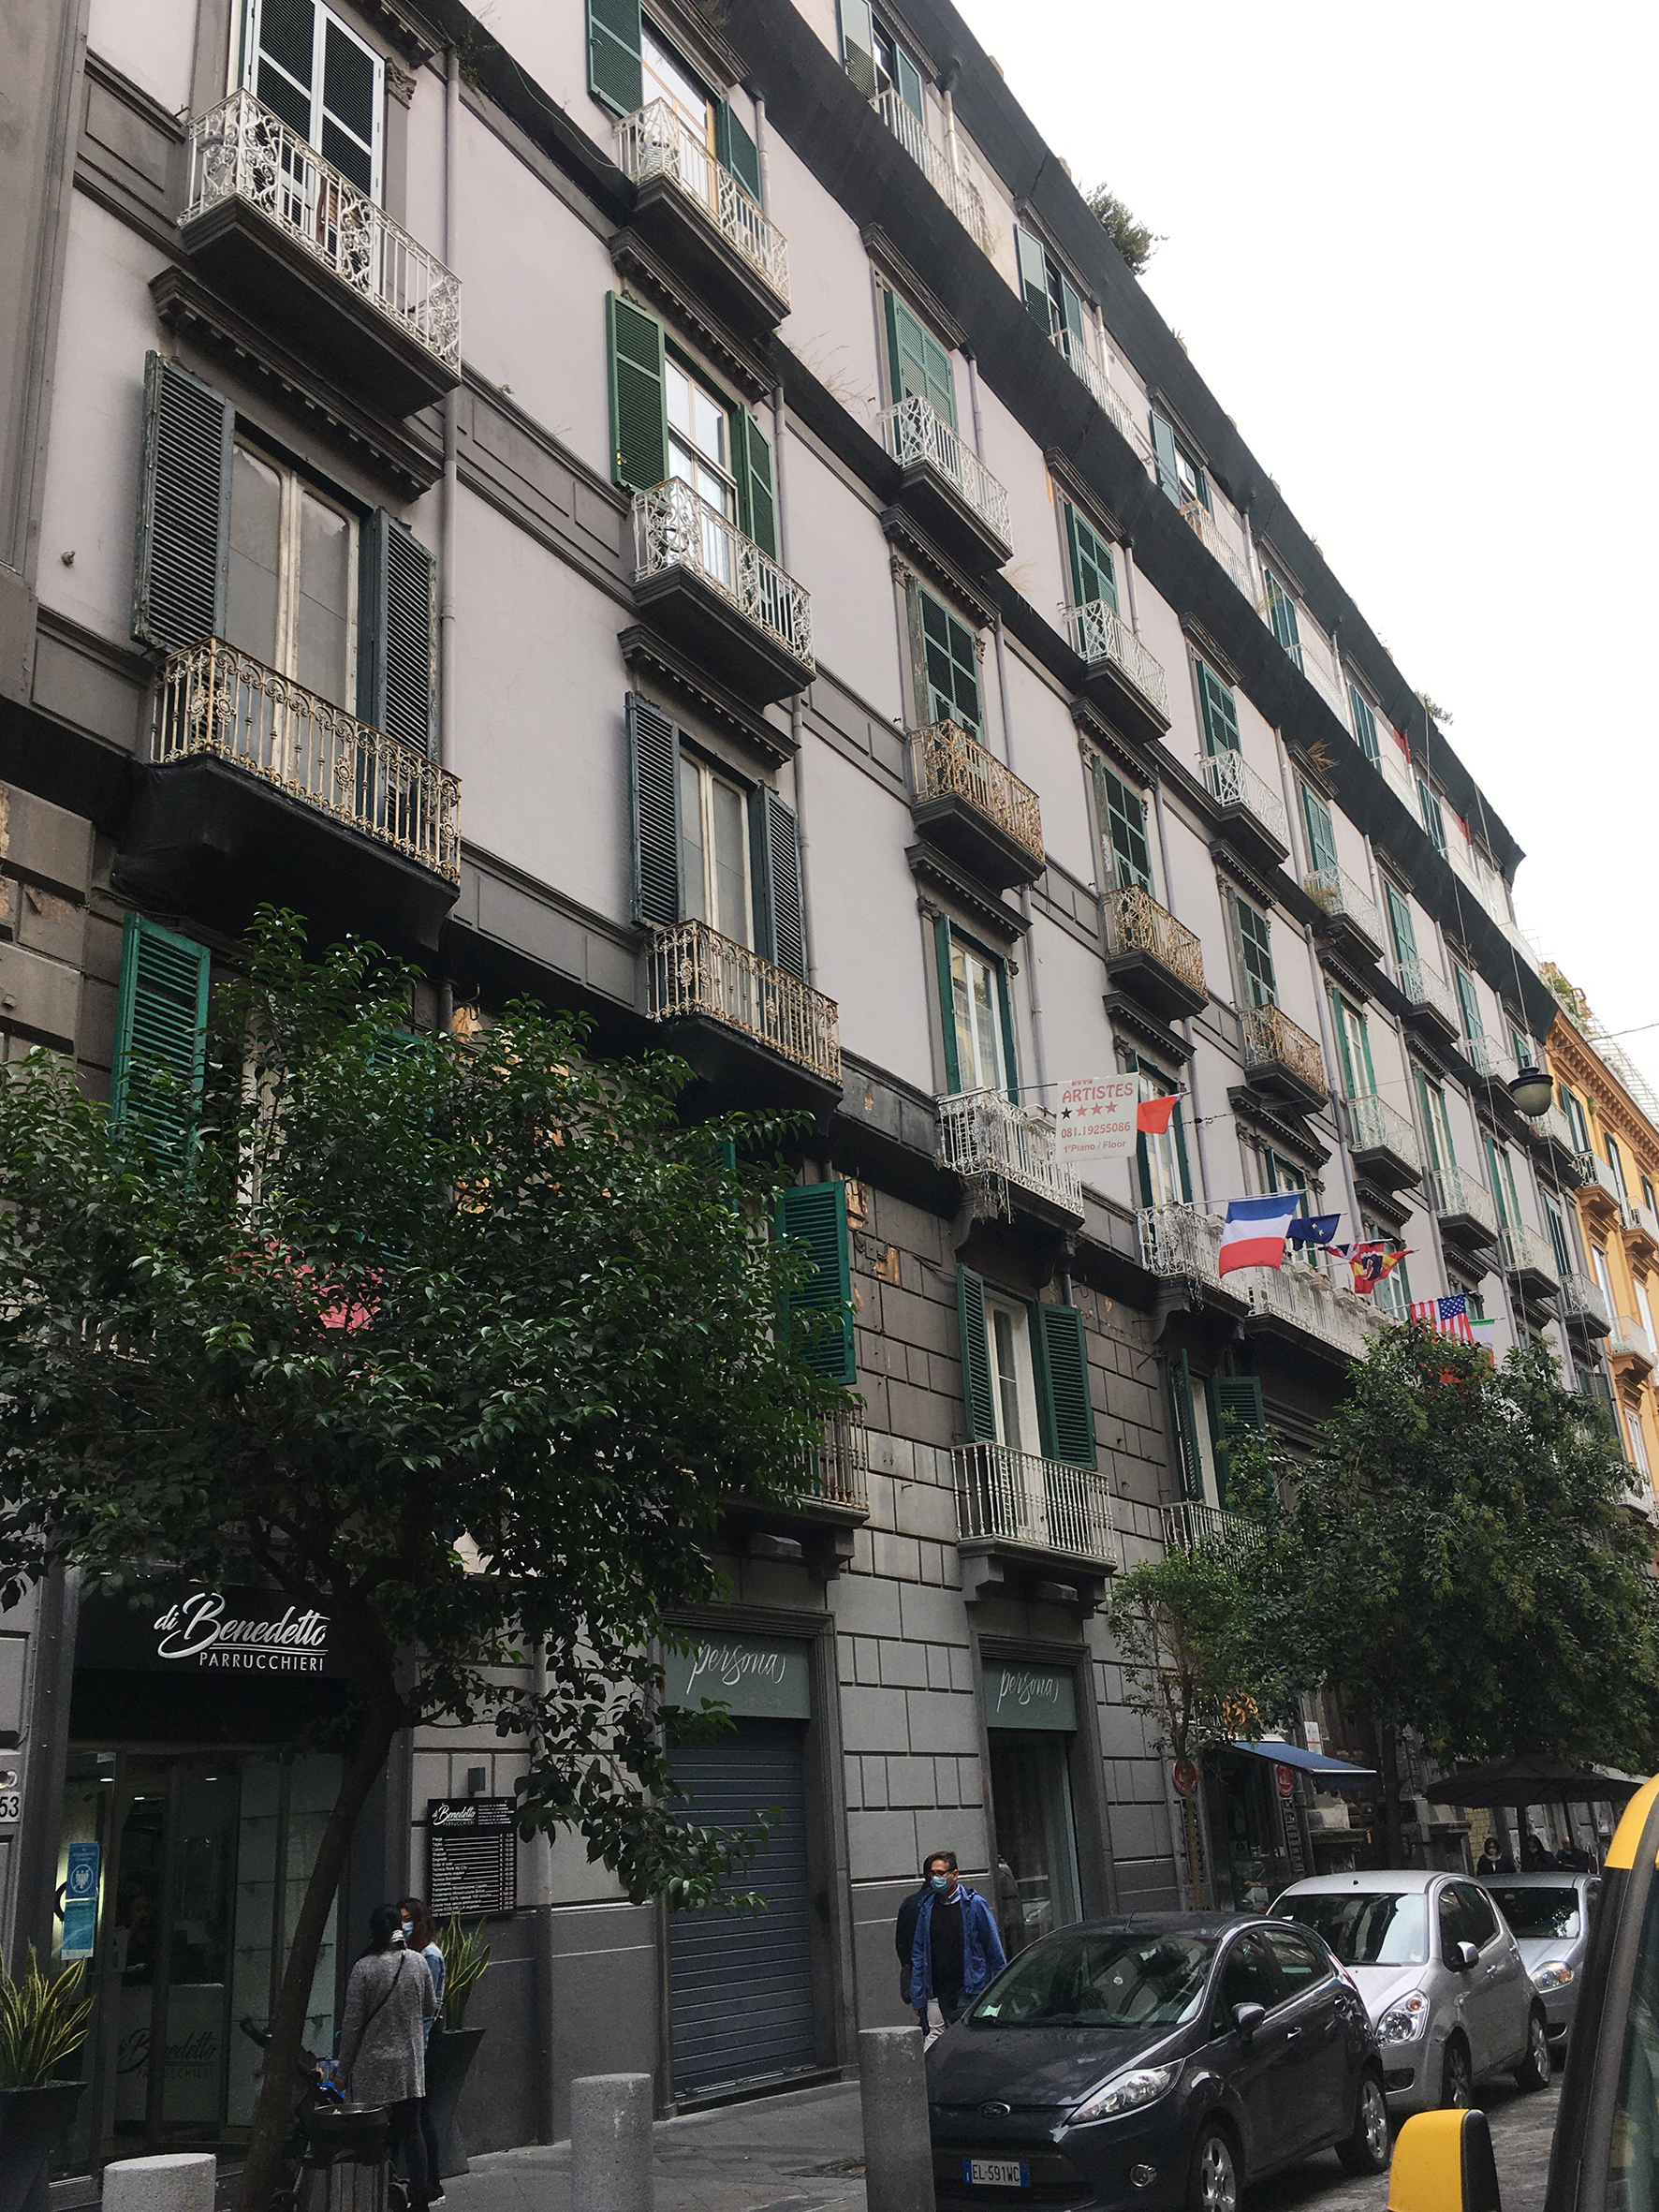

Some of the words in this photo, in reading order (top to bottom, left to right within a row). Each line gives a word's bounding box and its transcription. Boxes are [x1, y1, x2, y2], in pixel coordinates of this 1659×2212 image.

[1062, 1082, 1134, 1103] ARTISTES
[1061, 1121, 1131, 1139] 081.19255086
[1103, 1141, 1127, 1149] Floor
[154, 1604, 180, 1631] di
[157, 1592, 330, 1659] Benedetto
[199, 1652, 324, 1672] PARRUCCHIERI
[686, 1640, 786, 1695] persona
[996, 1668, 1059, 1713] persona
